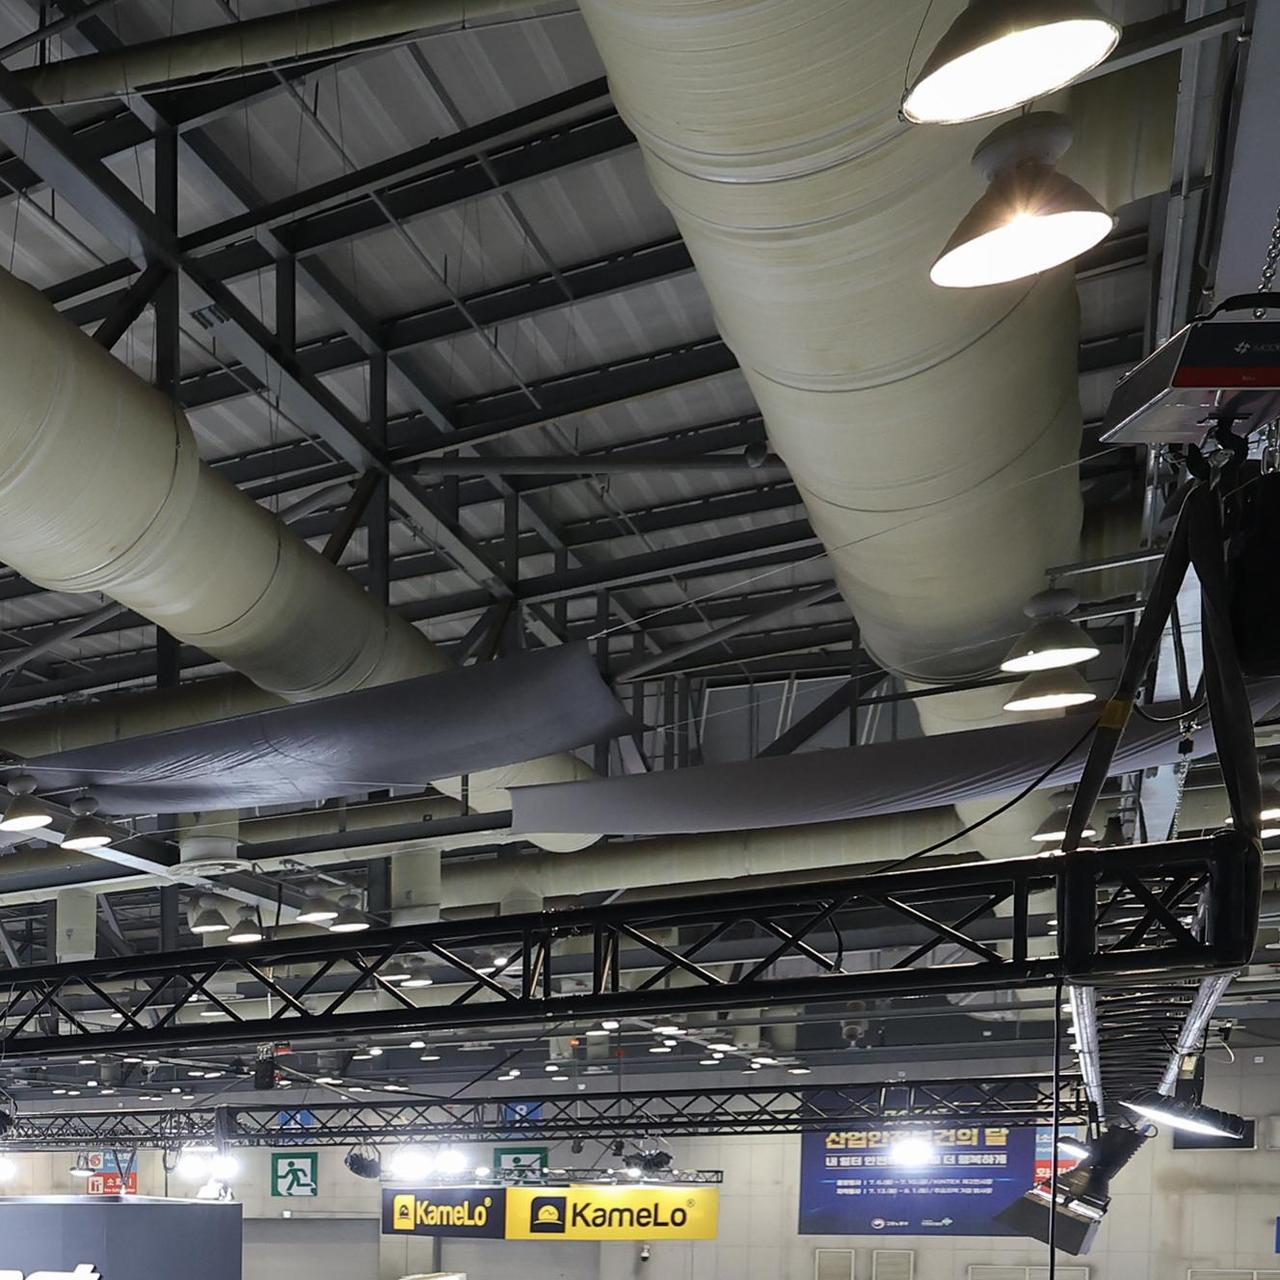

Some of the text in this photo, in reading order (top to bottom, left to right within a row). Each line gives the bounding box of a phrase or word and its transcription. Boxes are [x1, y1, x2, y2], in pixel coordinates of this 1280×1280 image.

[985, 1127, 1010, 1147] 달
[415, 1199, 488, 1227] KameLo
[571, 1202, 688, 1228] KameLo
